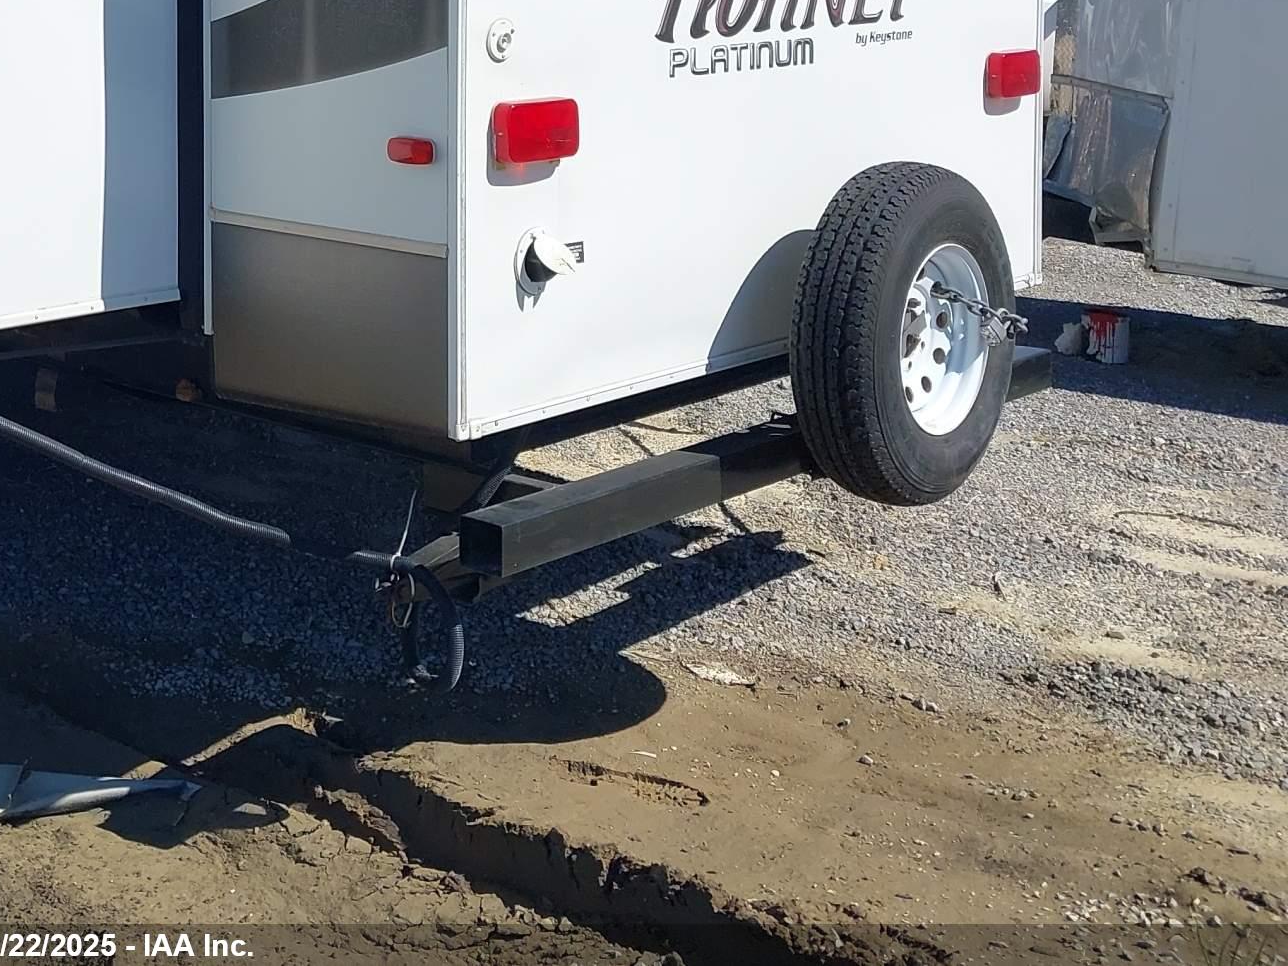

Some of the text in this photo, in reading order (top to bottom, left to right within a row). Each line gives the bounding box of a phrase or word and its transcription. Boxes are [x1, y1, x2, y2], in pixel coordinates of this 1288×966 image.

[855, 30, 913, 47] by Keystone
[669, 37, 814, 78] PLATINUM
